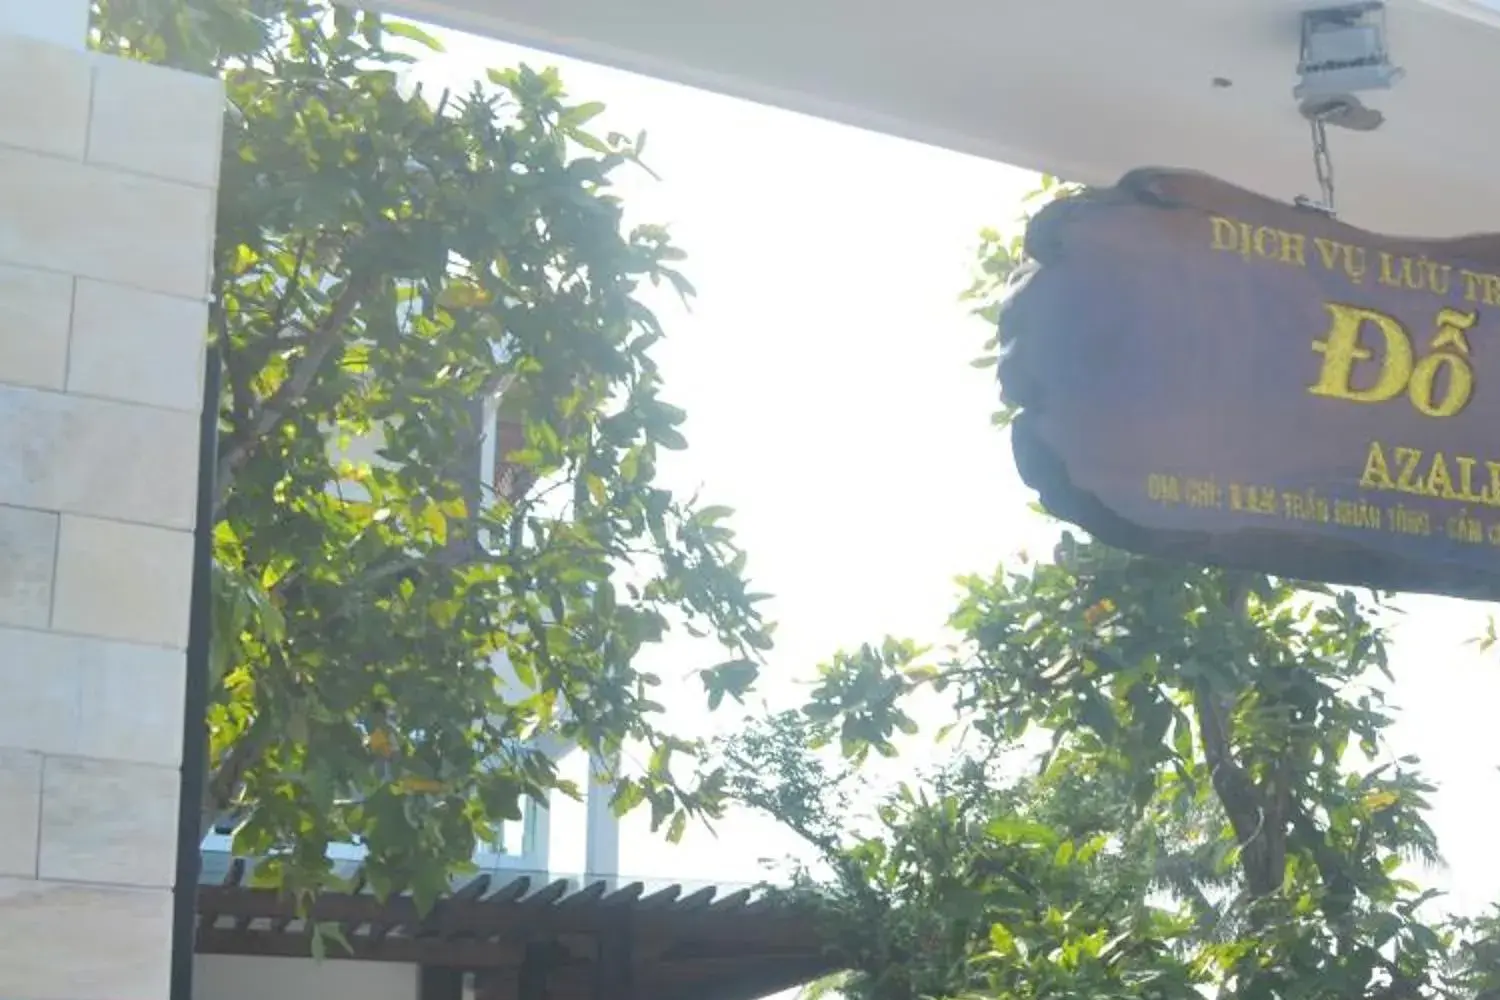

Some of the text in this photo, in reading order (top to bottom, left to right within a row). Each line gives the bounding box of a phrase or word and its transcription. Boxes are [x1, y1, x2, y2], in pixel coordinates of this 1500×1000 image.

[1209, 215, 1306, 267] DỊCH
[1313, 236, 1367, 285] VỤ
[1307, 302, 1478, 418] Đỗ
